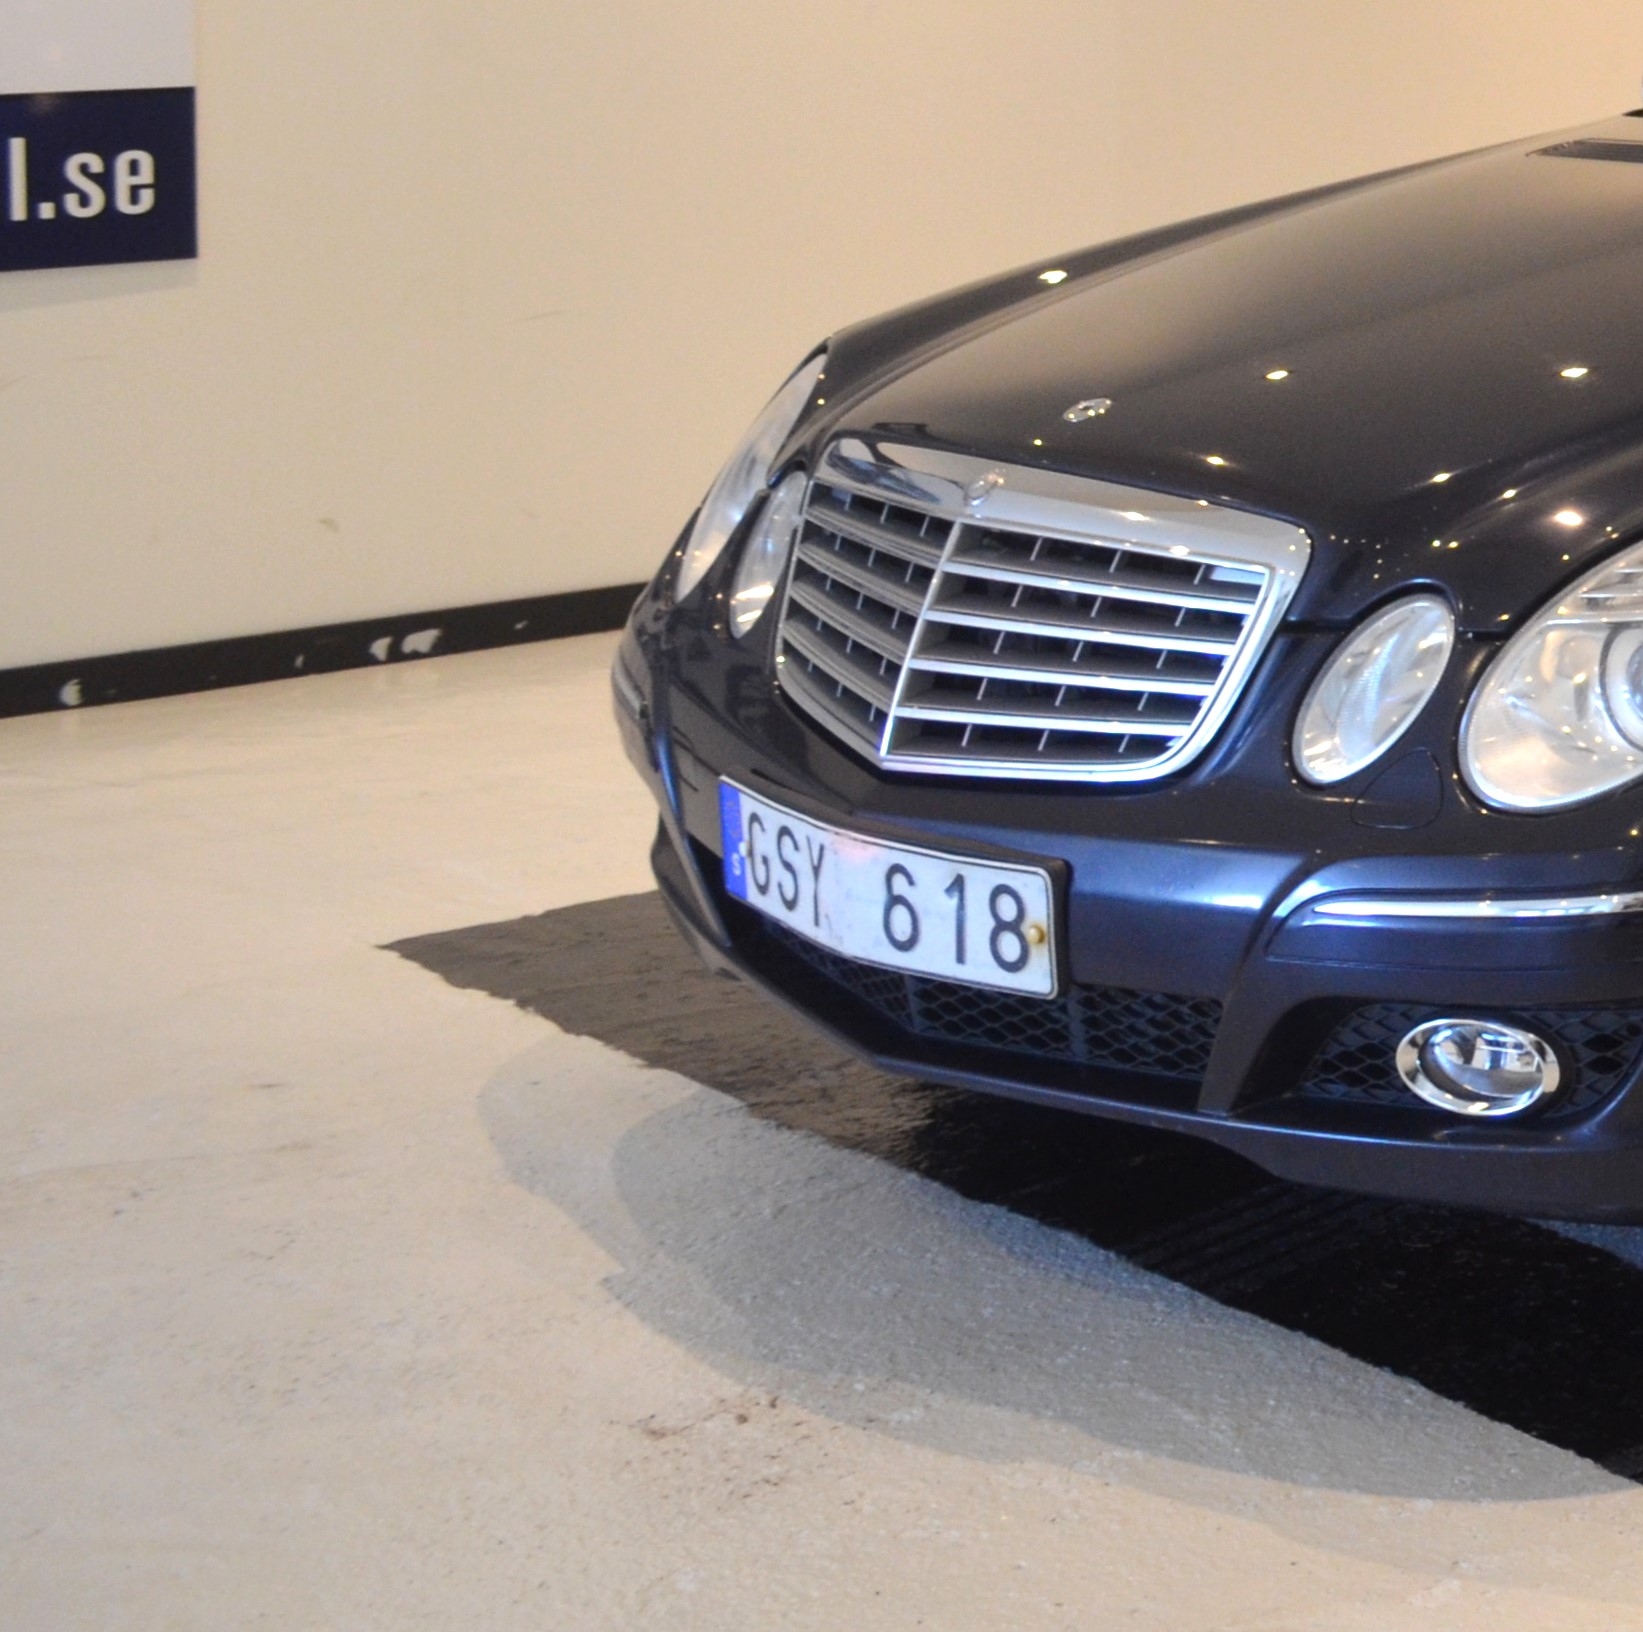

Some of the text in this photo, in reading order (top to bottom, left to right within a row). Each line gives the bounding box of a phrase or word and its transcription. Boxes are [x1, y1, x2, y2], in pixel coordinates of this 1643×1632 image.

[731, 851, 742, 877] S
[747, 811, 1030, 973] GSY 618
